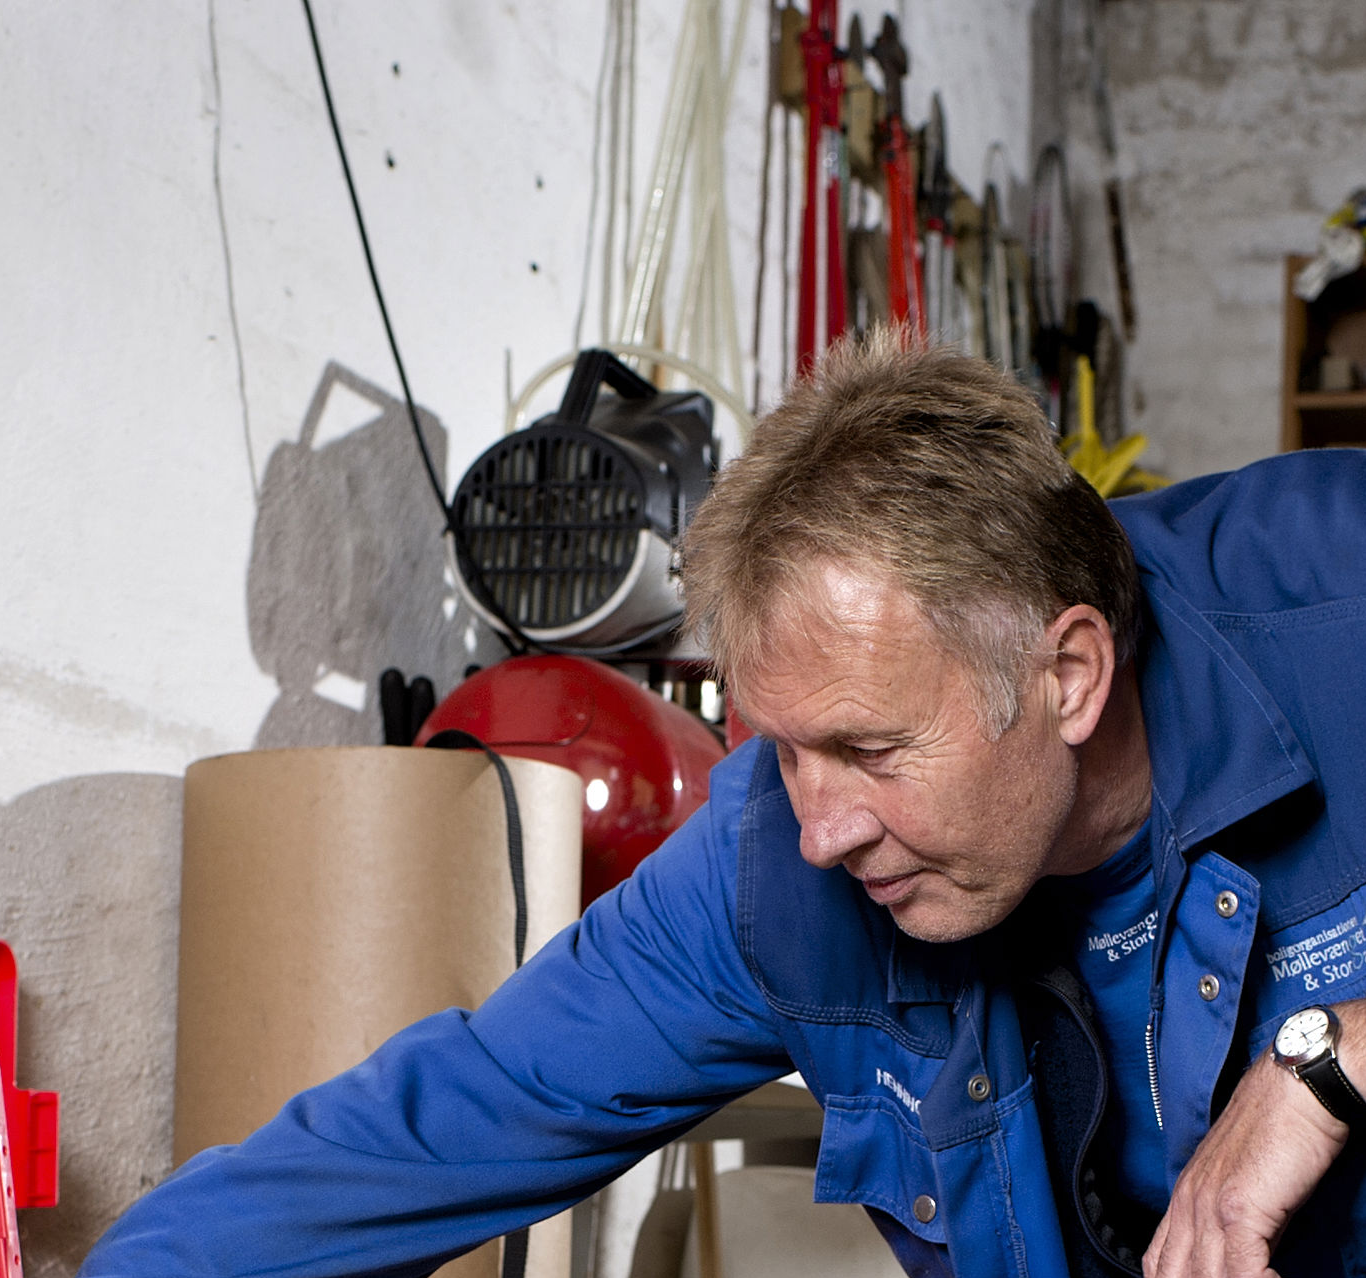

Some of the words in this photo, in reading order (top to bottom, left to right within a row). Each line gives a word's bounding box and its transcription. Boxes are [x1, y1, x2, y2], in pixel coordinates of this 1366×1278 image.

[1088, 910, 1158, 951] Møllevæng
[1107, 949, 1120, 962] &
[1272, 929, 1366, 982] Møllevænget
[1303, 973, 1320, 991] &
